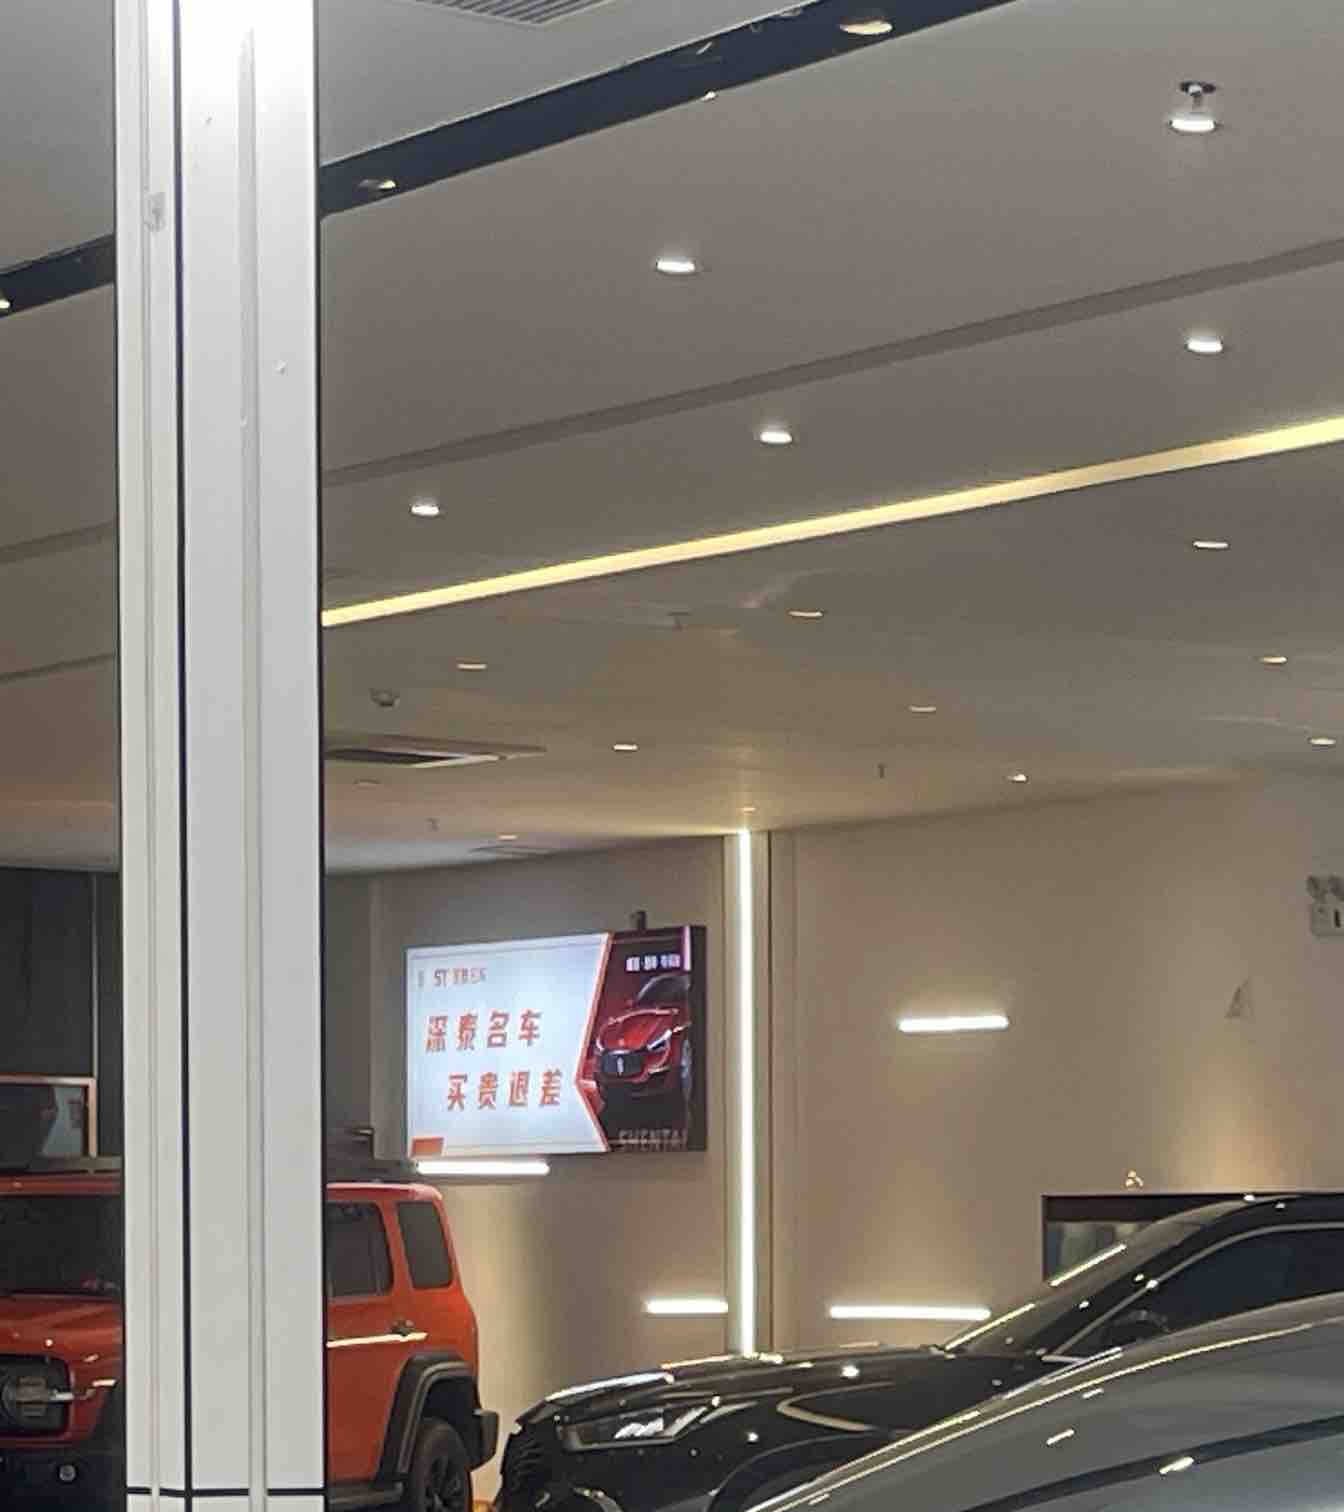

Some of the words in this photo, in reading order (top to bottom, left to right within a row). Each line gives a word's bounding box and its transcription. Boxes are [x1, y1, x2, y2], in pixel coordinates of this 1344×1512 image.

[425, 1008, 542, 1053] 深泰名车
[446, 1068, 564, 1112] 买贵退差
